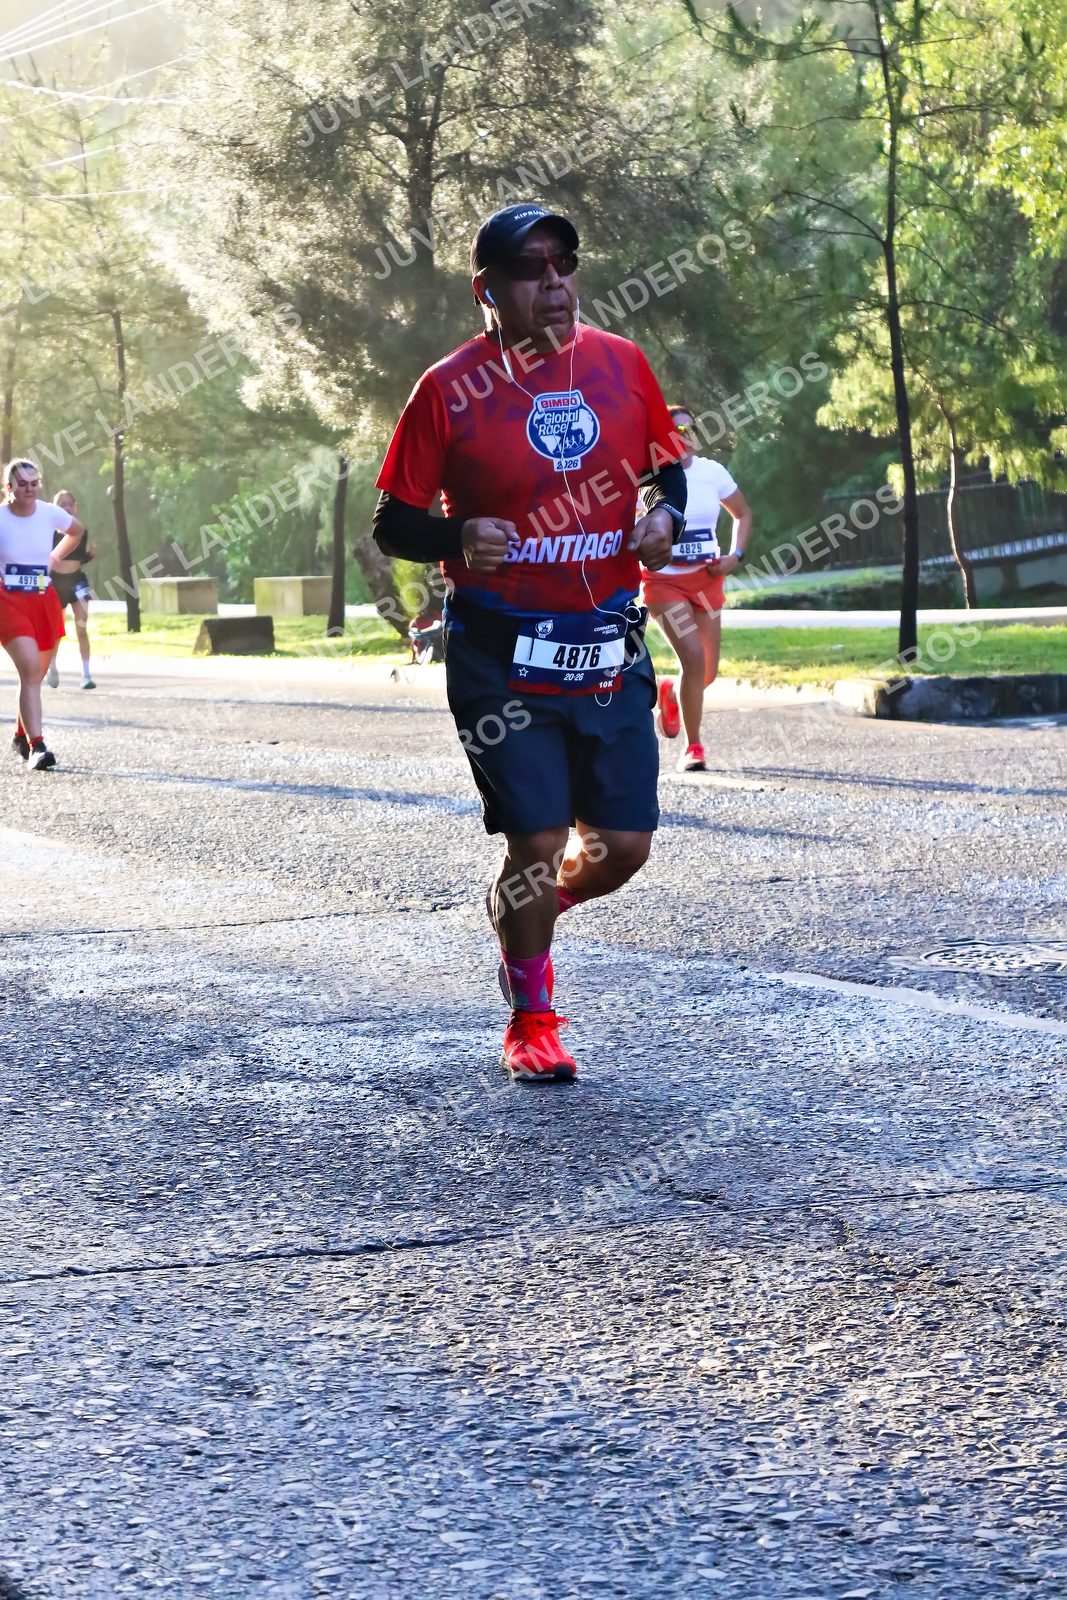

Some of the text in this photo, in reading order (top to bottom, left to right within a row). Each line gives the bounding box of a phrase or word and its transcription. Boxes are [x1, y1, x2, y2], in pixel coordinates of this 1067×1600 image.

[541, 397, 578, 408] BIMBO
[544, 408, 579, 424] Global
[538, 423, 567, 436] Race
[503, 529, 623, 563] SANTIAGO
[680, 543, 702, 554] 4829
[552, 645, 601, 669] 4876
[599, 680, 613, 688] 10K
